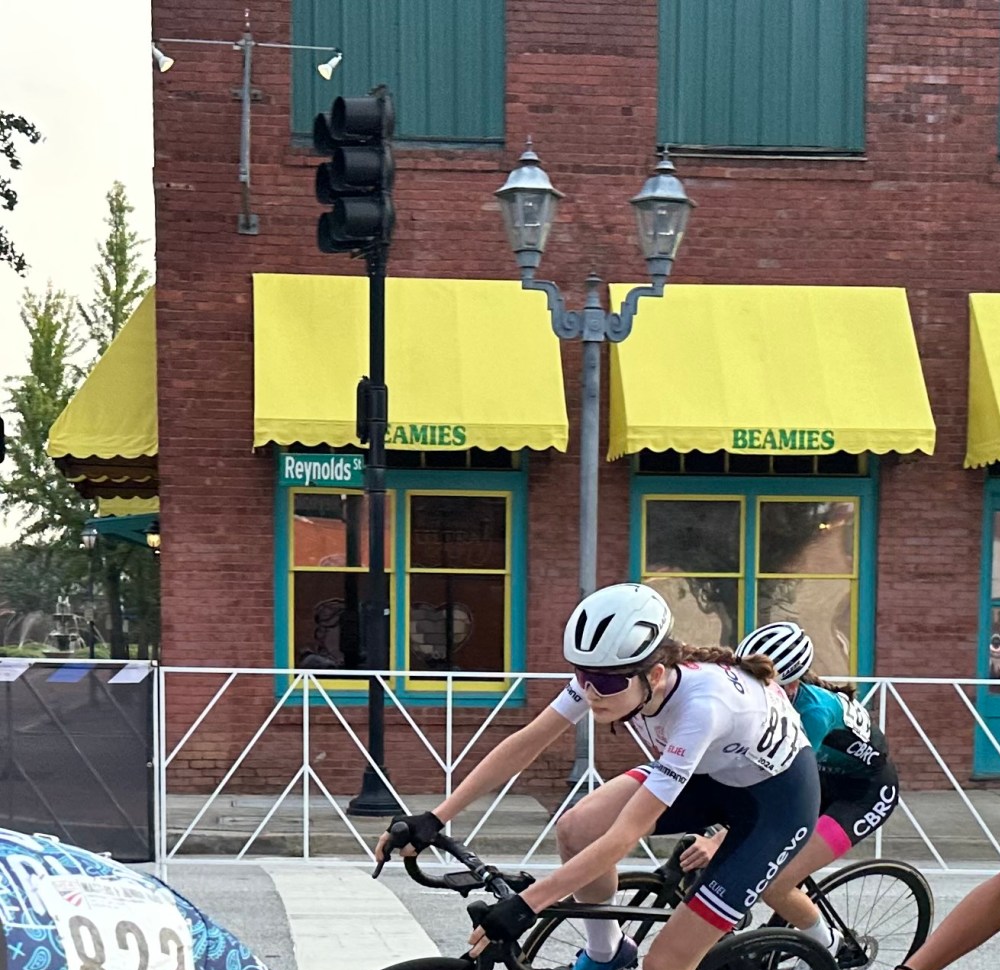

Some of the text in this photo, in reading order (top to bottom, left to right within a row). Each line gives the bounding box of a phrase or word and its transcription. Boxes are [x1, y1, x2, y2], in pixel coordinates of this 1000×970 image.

[383, 424, 467, 447] EAMIES
[732, 428, 835, 450] BEAMIES
[284, 456, 363, 486] Reynolds St
[846, 741, 881, 766] CBRC
[853, 785, 897, 837] CBRC
[744, 827, 808, 907] dcdevo
